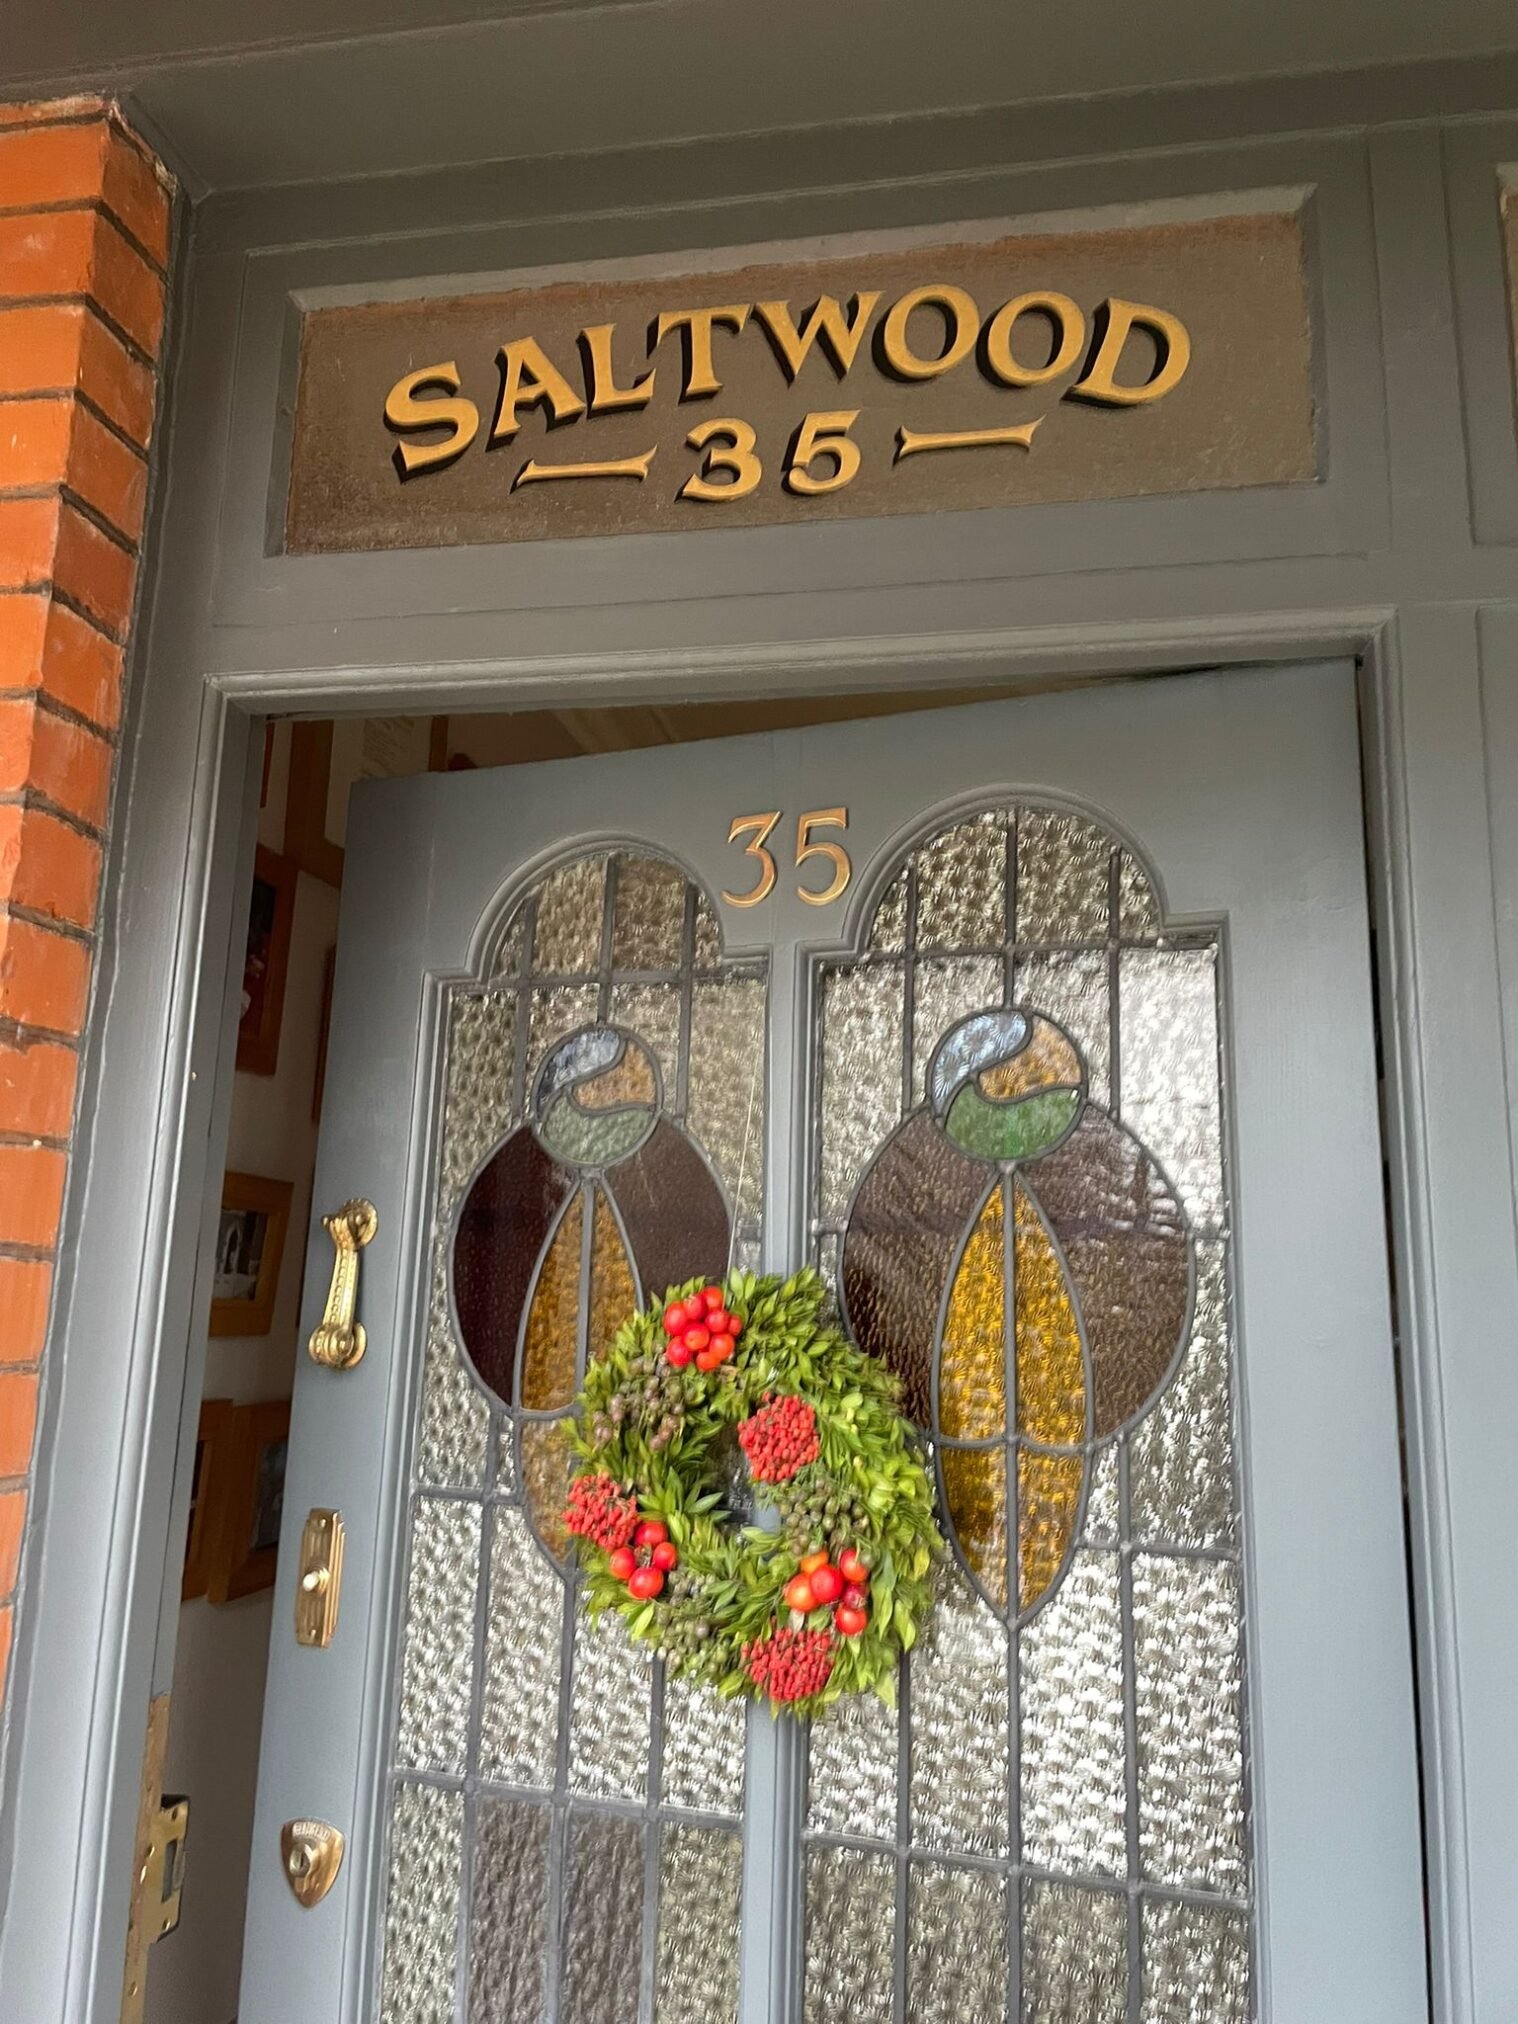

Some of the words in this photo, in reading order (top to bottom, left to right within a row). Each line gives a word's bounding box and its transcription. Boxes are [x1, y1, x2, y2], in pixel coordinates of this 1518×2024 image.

[385, 284, 1193, 472] SALTWOOD
[682, 408, 862, 502] 35
[721, 807, 852, 909] 35
